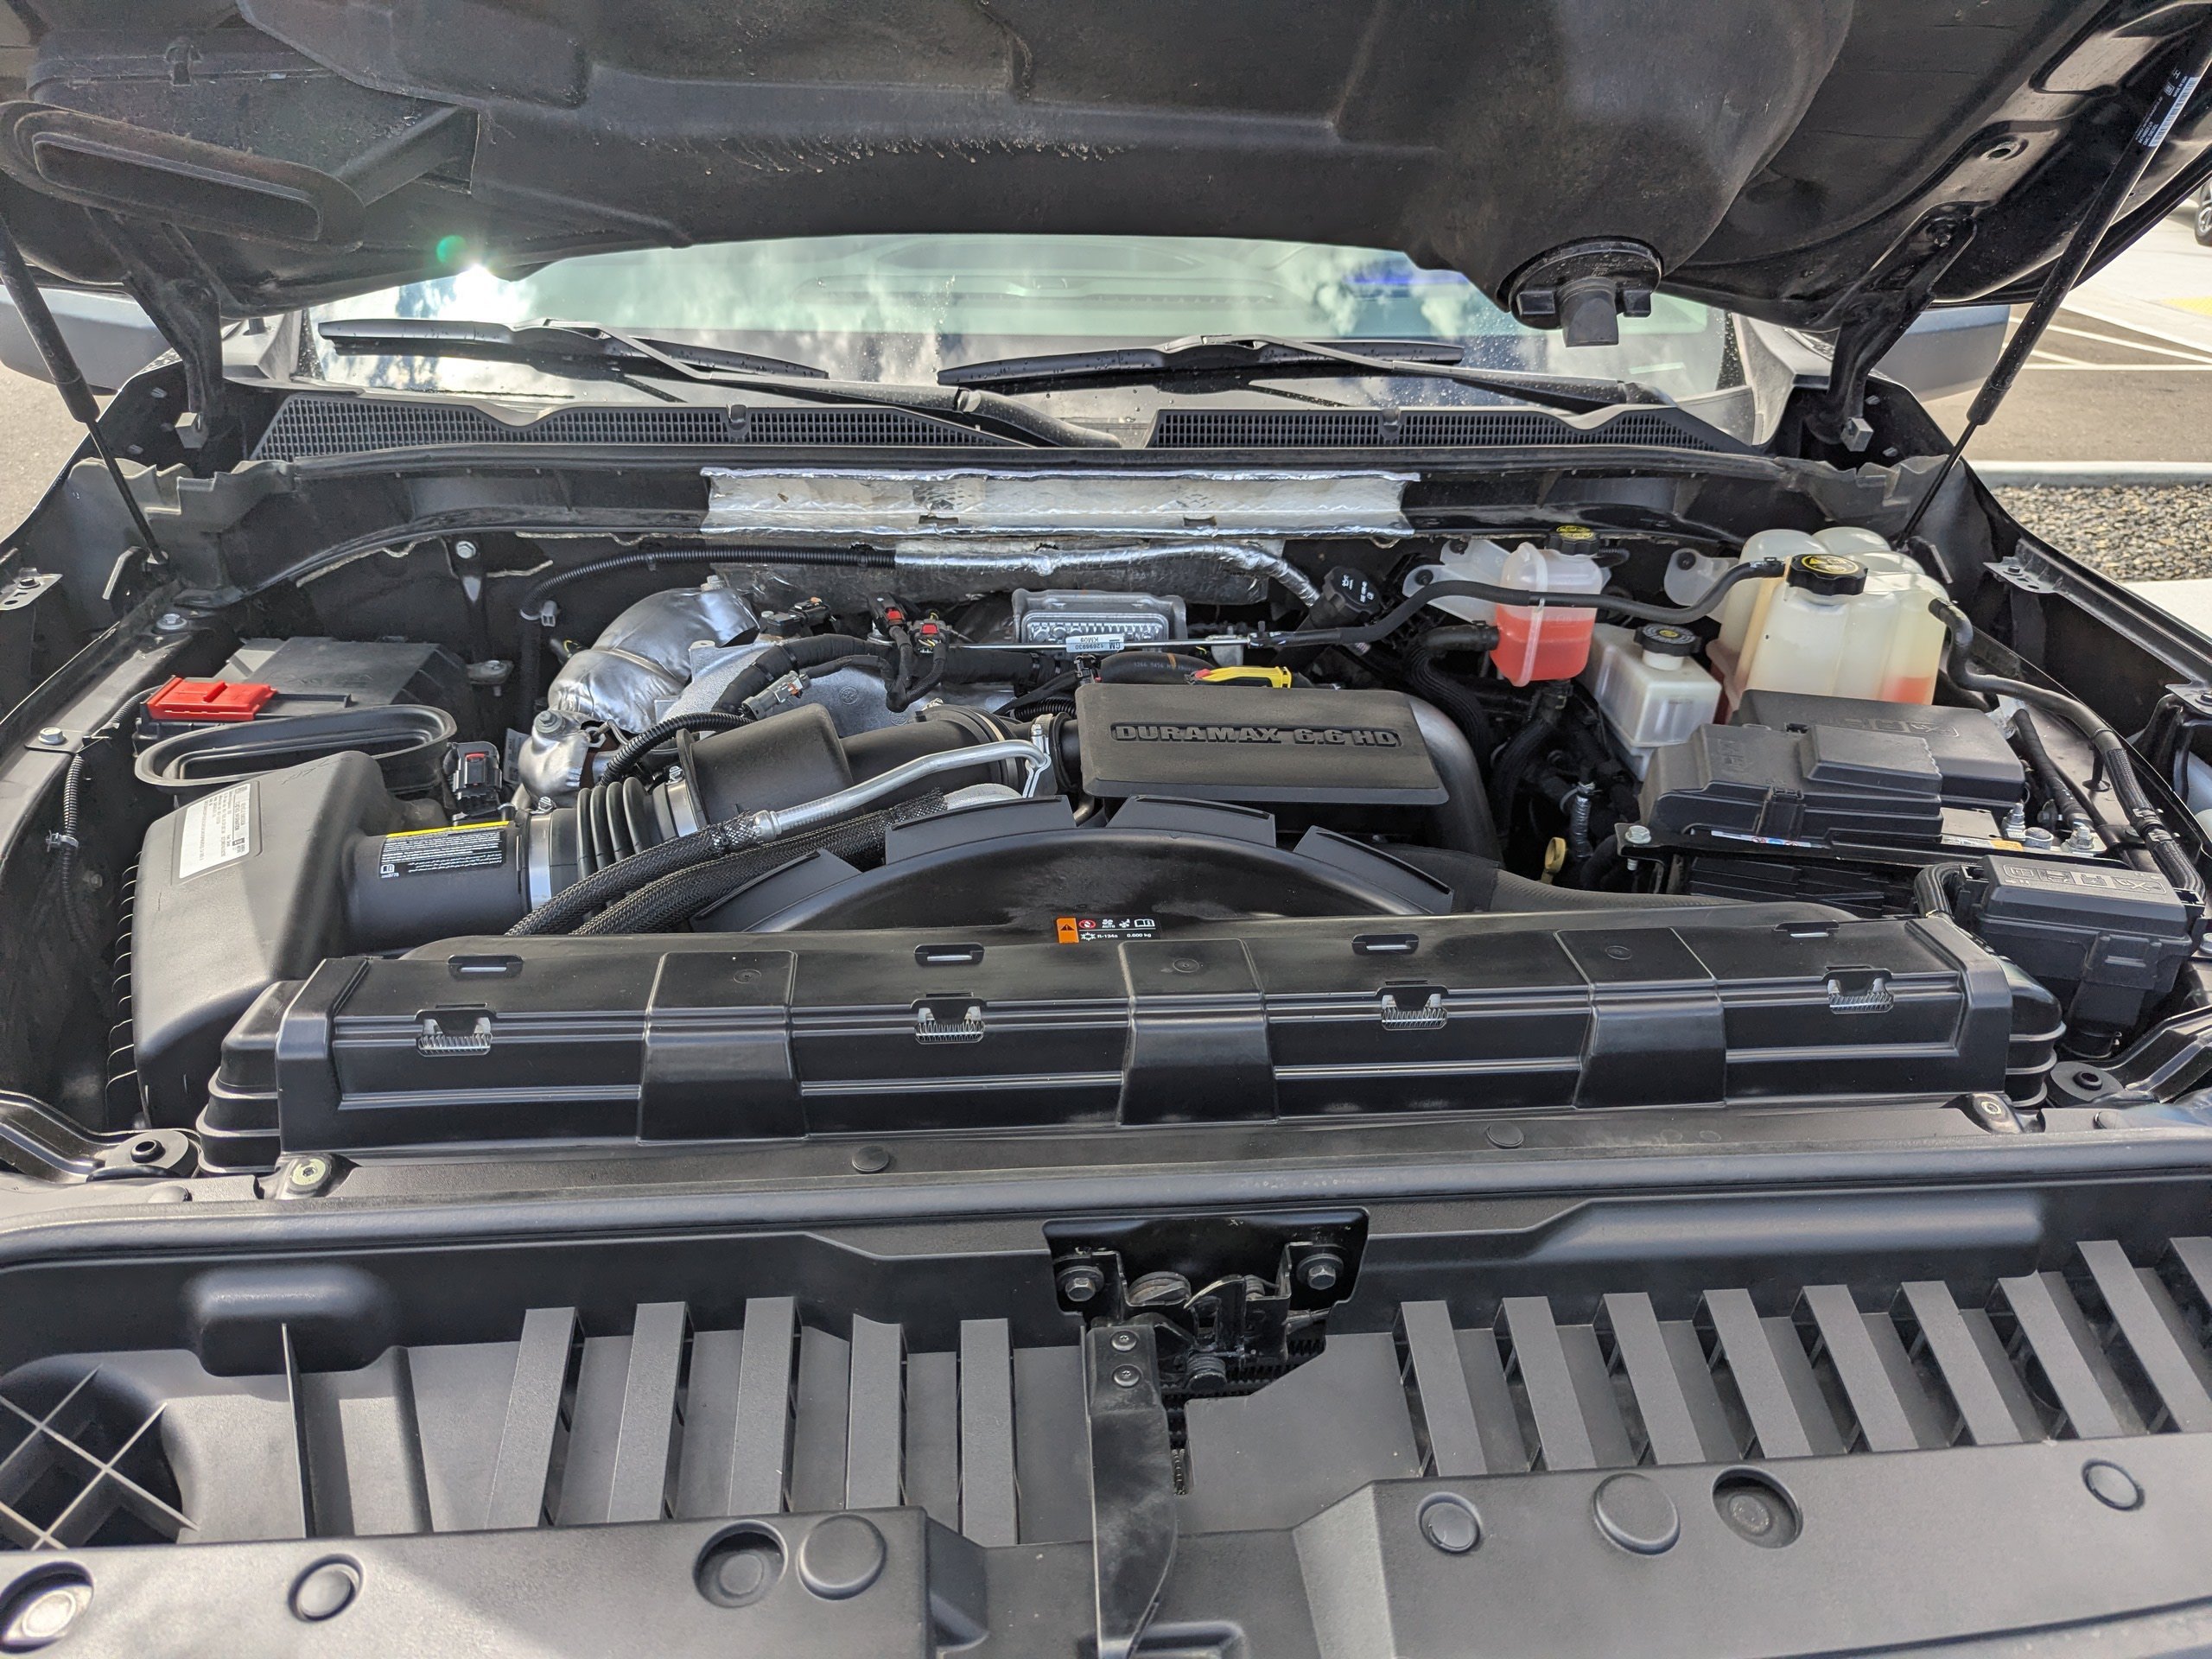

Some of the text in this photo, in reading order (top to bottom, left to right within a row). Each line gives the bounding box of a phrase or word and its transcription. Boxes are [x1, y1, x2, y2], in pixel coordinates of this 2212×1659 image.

[1109, 639, 1121, 650] GM
[1116, 725, 1397, 747] DURAMAX 6.6 HD
